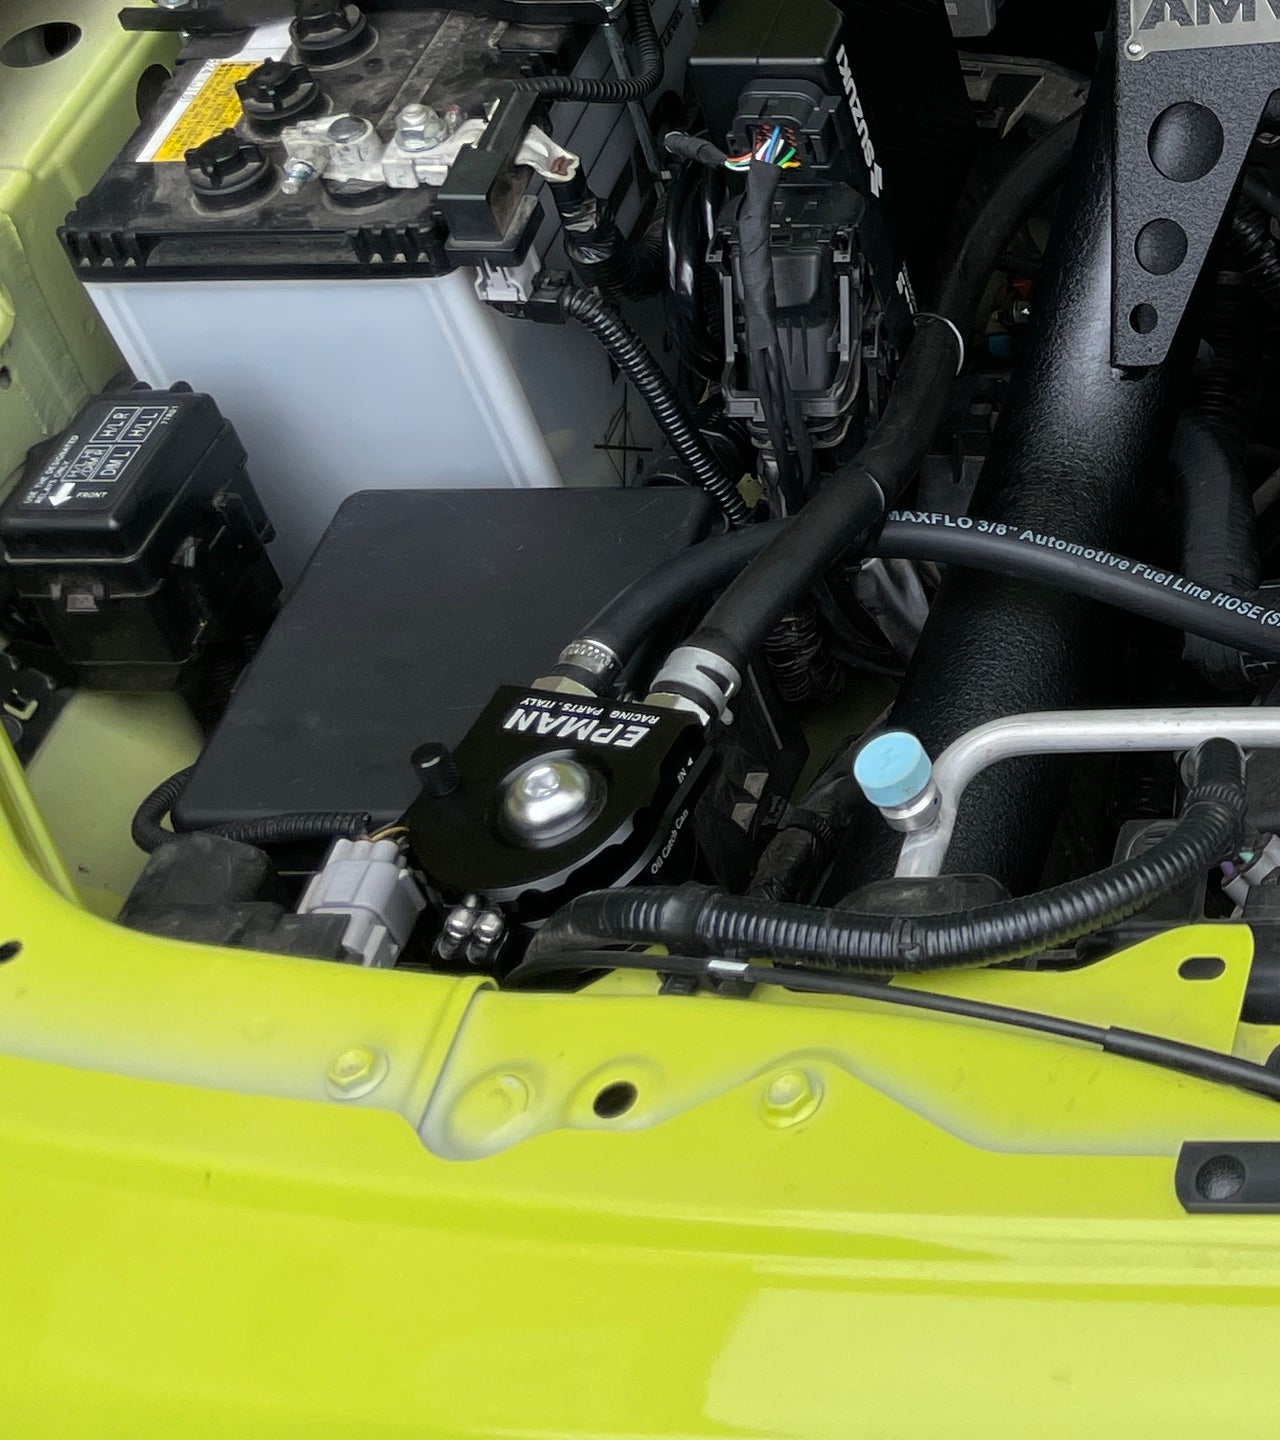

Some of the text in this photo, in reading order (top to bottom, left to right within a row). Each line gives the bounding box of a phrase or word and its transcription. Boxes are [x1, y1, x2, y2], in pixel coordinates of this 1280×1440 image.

[836, 43, 875, 168] SUZUKI
[887, 509, 973, 529] MAXFLO
[977, 519, 1018, 536] 3/8"
[1019, 529, 1130, 571] Automotive
[1131, 562, 1176, 586] Fuel
[1172, 577, 1212, 601] Line
[1211, 592, 1264, 620] HOSE
[520, 696, 557, 709] ITALY
[609, 710, 661, 725] RACING
[503, 708, 650, 748] EPMAN
[676, 768, 688, 784] IN
[650, 809, 689, 875] Oil Catch Can
